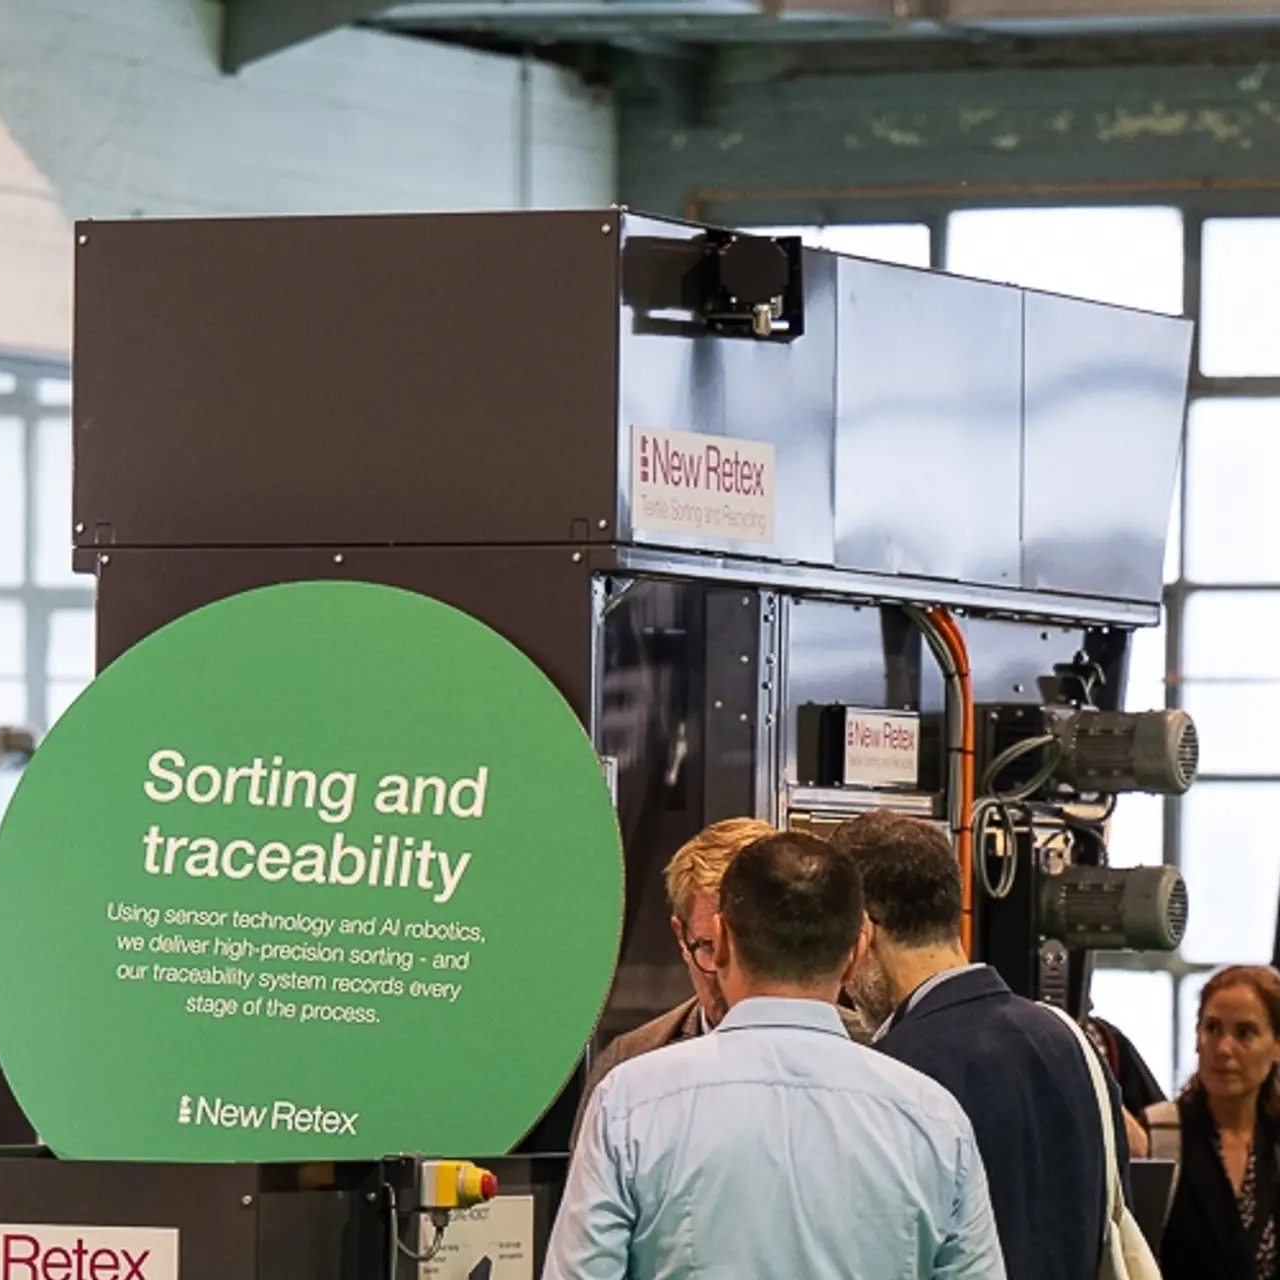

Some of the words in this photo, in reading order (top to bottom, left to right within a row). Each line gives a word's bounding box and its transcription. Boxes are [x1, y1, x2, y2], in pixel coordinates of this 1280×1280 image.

[652, 437, 702, 488] New
[705, 445, 764, 496] Retex
[855, 722, 879, 748] New
[883, 722, 915, 751] Retex
[144, 750, 356, 823] Sorting
[374, 766, 488, 817] and
[143, 826, 471, 903] traceability
[107, 902, 160, 926] Using
[164, 909, 225, 926] sensor
[233, 911, 334, 936] technology
[340, 917, 375, 936] and
[380, 918, 400, 936] AI
[405, 920, 486, 943] robotics,
[117, 936, 144, 951] we
[149, 934, 211, 955] deliver
[214, 938, 344, 963] high-precision
[349, 949, 413, 971] sorting
[433, 952, 470, 971] and
[117, 965, 147, 981] our
[153, 964, 253, 989] traceability
[259, 974, 326, 993] system
[332, 976, 403, 997] records
[409, 983, 461, 1003] every
[186, 995, 237, 1018] stage
[243, 997, 263, 1015] of
[267, 999, 295, 1018] the
[300, 1004, 380, 1024] process.
[196, 1097, 265, 1129] New
[271, 1101, 359, 1135] Retex
